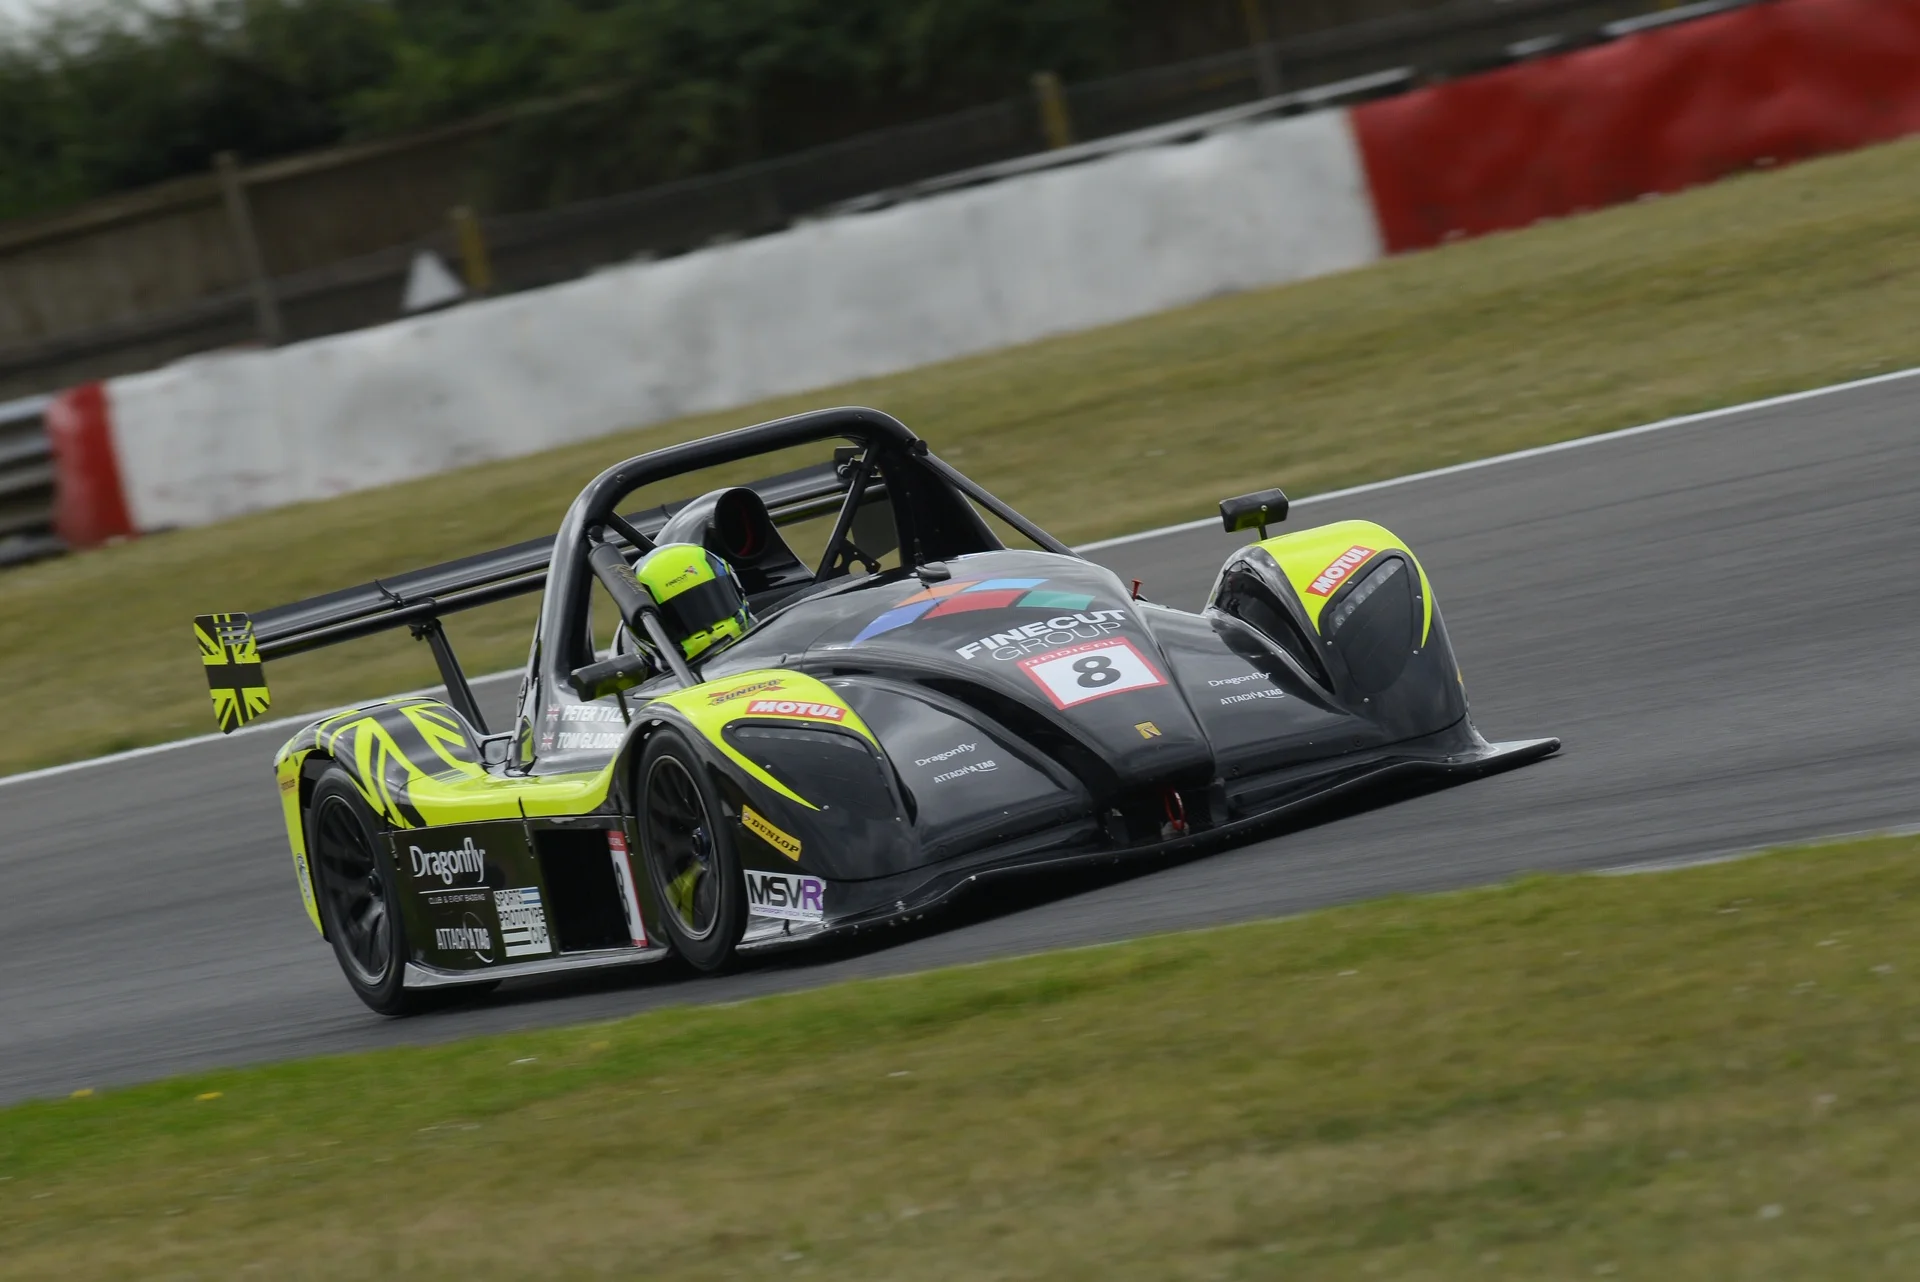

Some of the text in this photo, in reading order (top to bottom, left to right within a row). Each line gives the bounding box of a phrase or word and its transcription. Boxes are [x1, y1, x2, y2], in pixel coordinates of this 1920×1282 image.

[1311, 548, 1370, 594] MOTUL
[955, 609, 1127, 660] FINECUT
[992, 621, 1122, 661] GROUP
[1024, 640, 1125, 667] RADICAL
[1072, 655, 1121, 688] 8
[1207, 671, 1271, 687] Dragonfly
[715, 679, 778, 704] SUNOCO
[561, 704, 599, 721] PETER
[750, 701, 840, 719] MOTUL
[556, 732, 581, 749] TOM
[914, 742, 978, 767] Dragonfly
[751, 819, 800, 852] DUNLOP
[409, 837, 486, 885] Dragonfly
[747, 873, 824, 911] MSVR
[498, 907, 546, 928] PROTOTYPE
[530, 925, 548, 945] CUP
